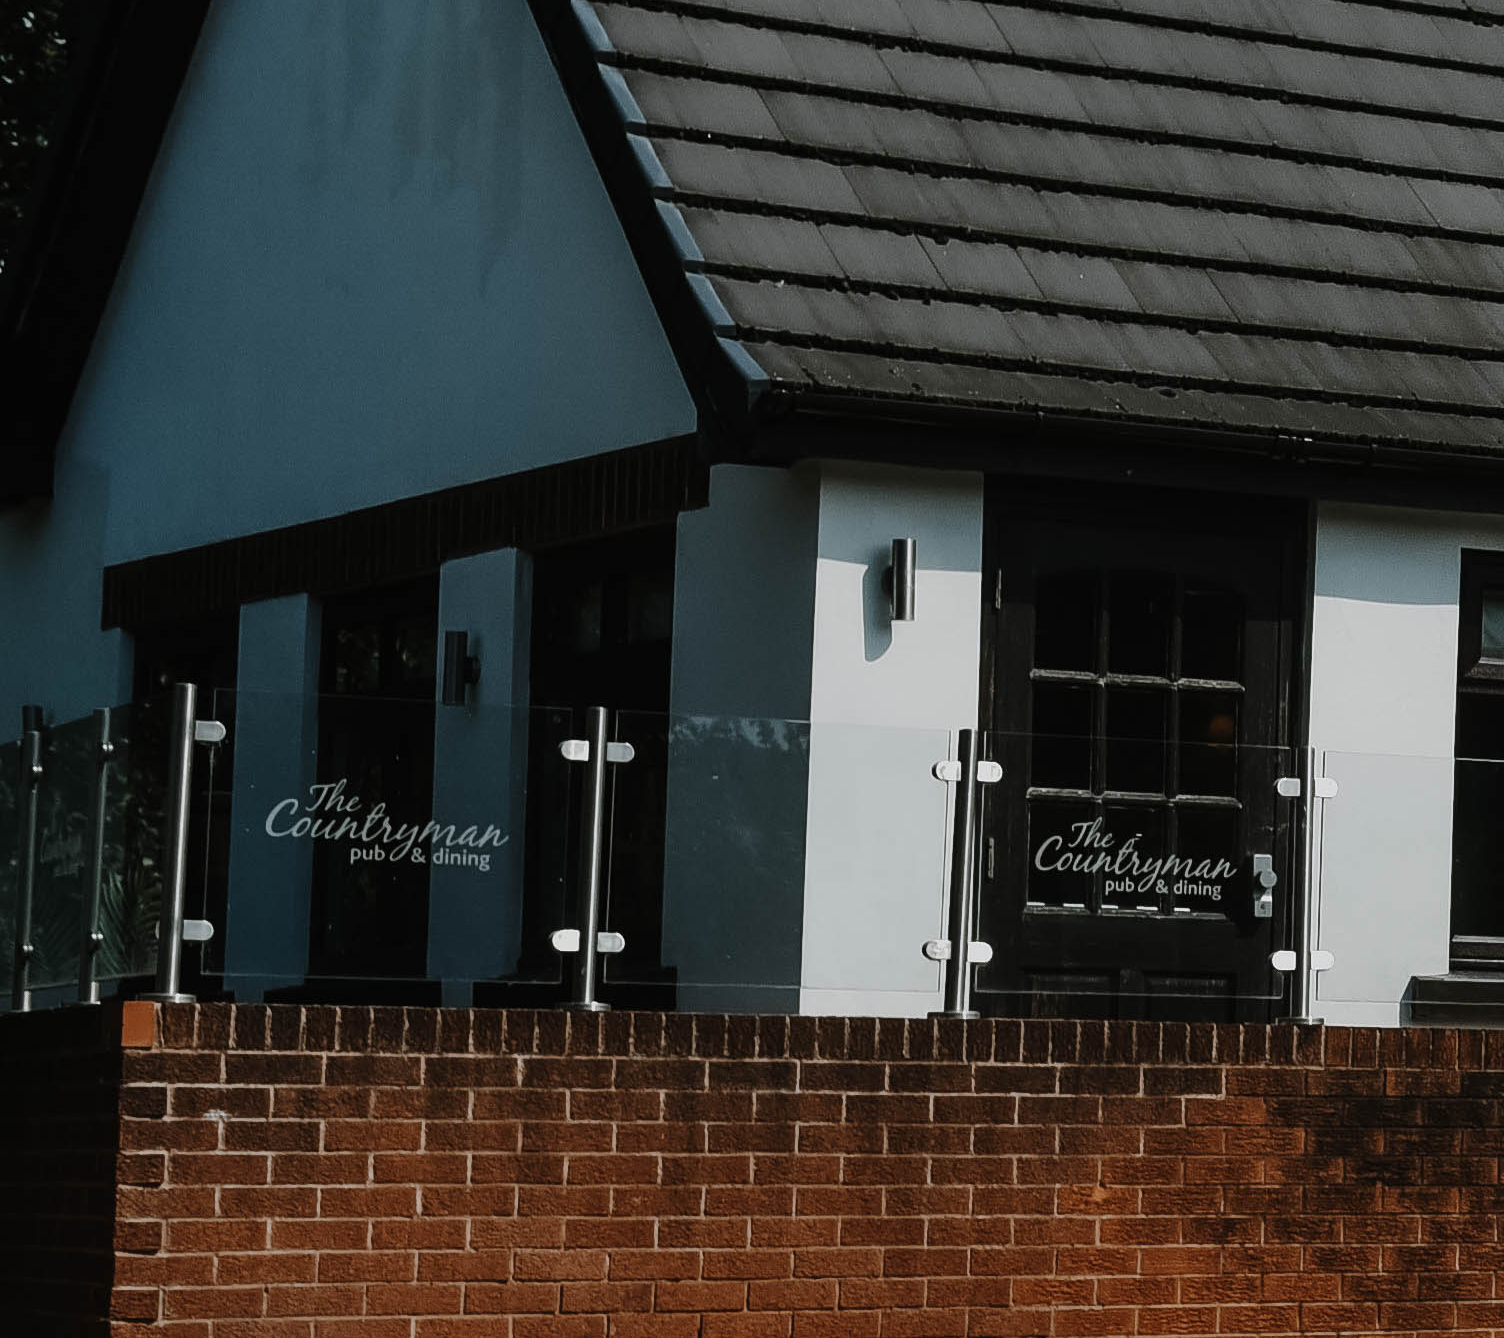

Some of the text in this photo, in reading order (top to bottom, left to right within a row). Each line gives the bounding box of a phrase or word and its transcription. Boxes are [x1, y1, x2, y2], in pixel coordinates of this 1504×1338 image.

[305, 778, 362, 812] The
[265, 798, 509, 862] Countryman
[1068, 816, 1115, 848] The
[350, 844, 491, 871] pub & dining
[1034, 835, 1238, 893] Countryman
[1105, 876, 1222, 901] pub & dining
